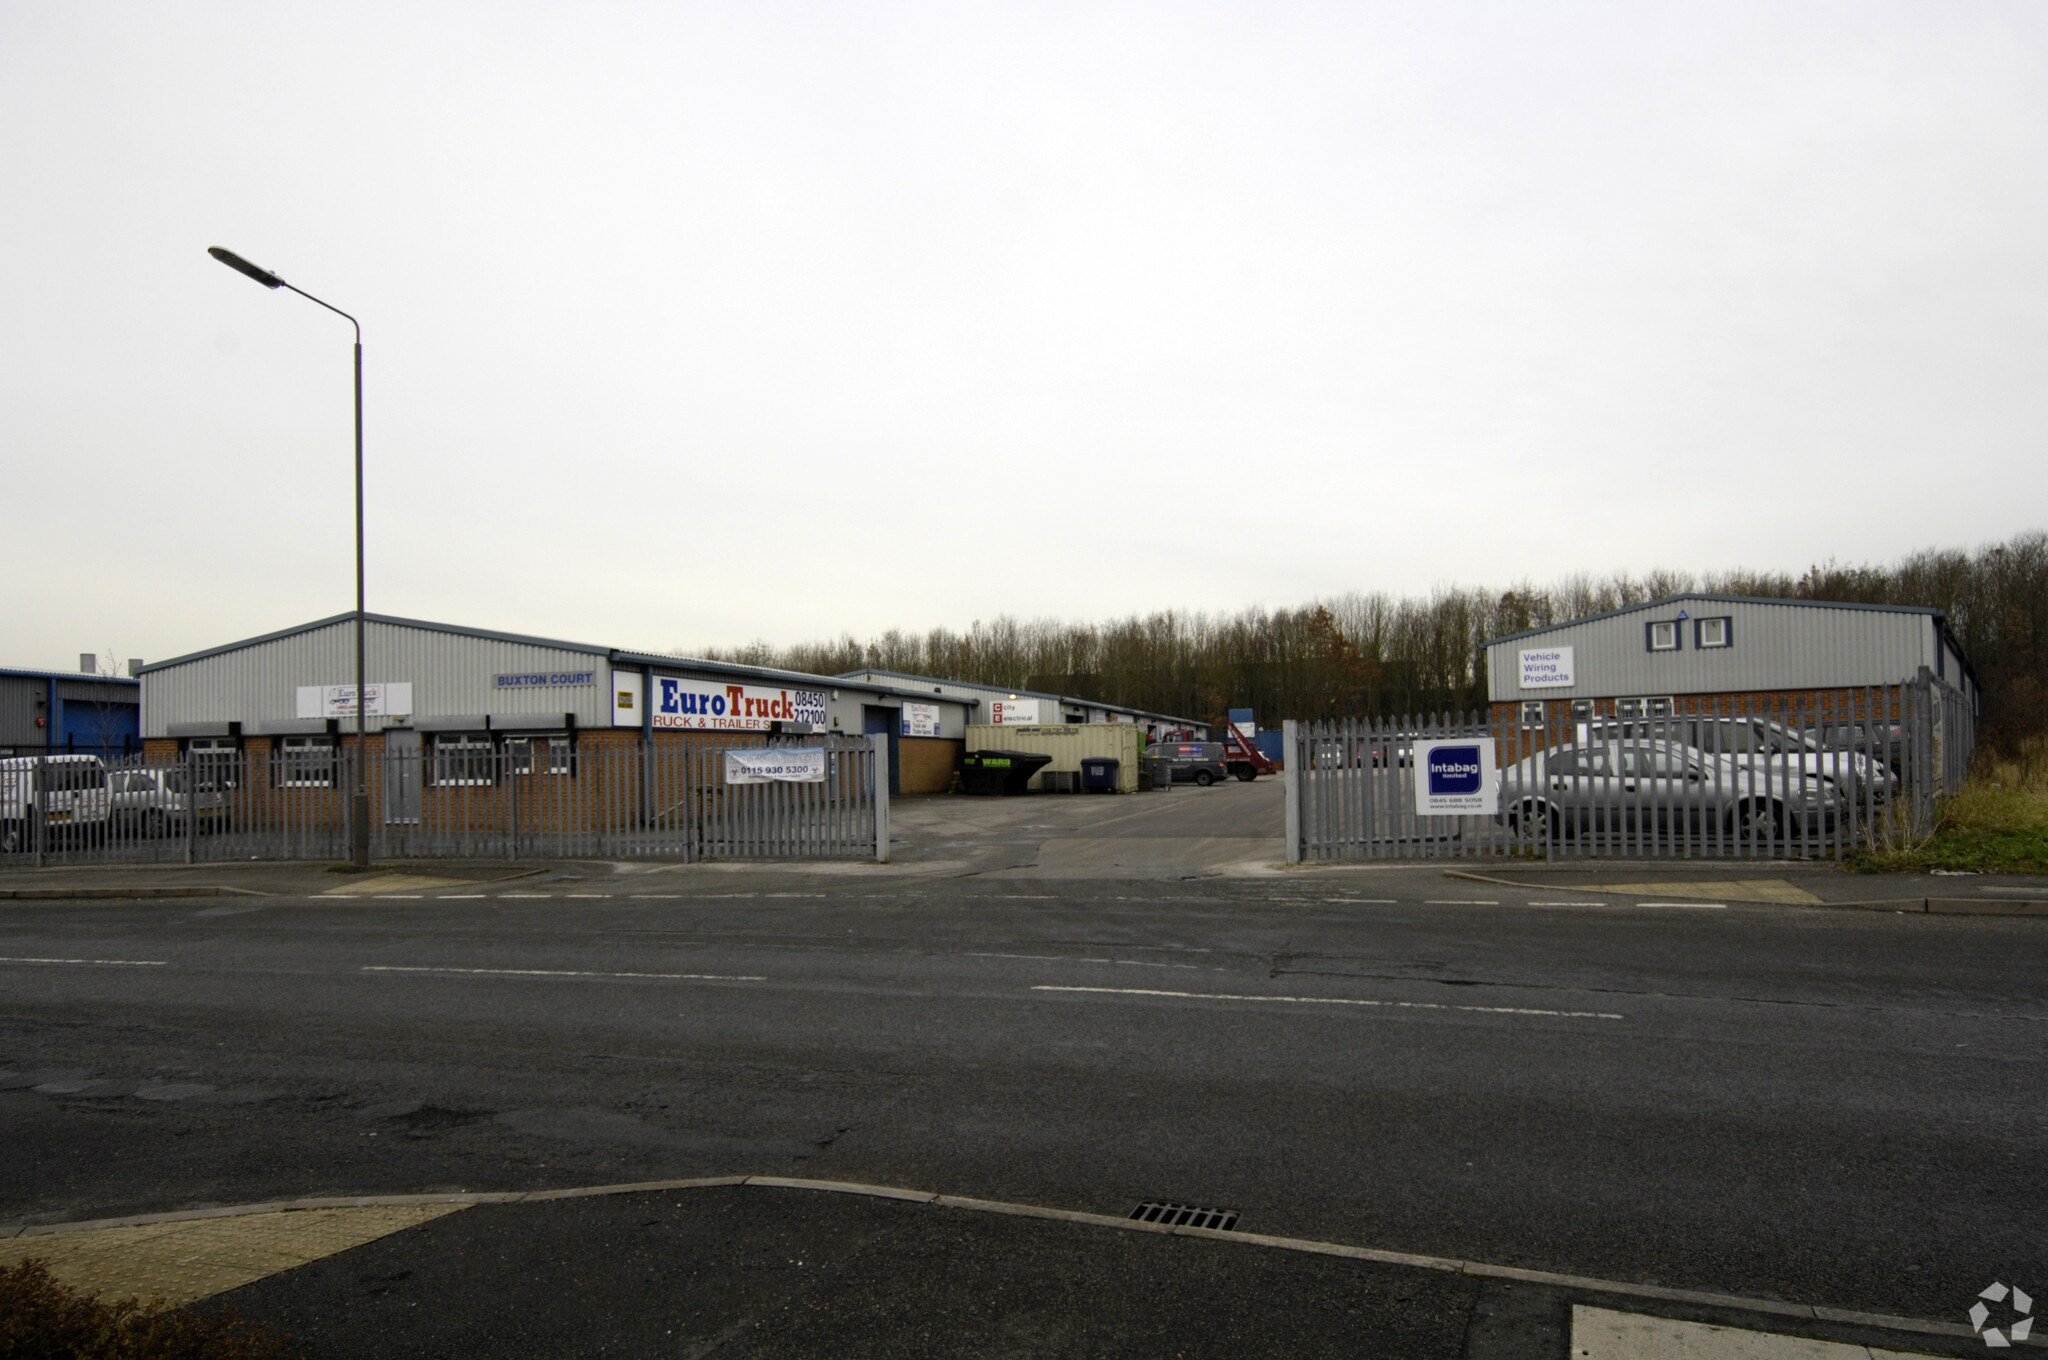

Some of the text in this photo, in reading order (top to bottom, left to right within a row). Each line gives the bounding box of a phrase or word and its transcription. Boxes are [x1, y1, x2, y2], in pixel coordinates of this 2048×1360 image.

[1523, 652, 1560, 661] Vehicle
[1524, 664, 1556, 673] Wiring
[497, 673, 592, 686] BUXTON COURT
[1523, 673, 1569, 683] Products
[795, 691, 824, 708] 08450
[794, 708, 826, 725] 212100
[653, 715, 692, 728] RUCK
[698, 718, 706, 728] &
[711, 718, 760, 729] TRAILER
[982, 758, 1011, 766] WARD
[741, 765, 809, 775] 0115 930 5300
[1431, 763, 1478, 774] Intabag
